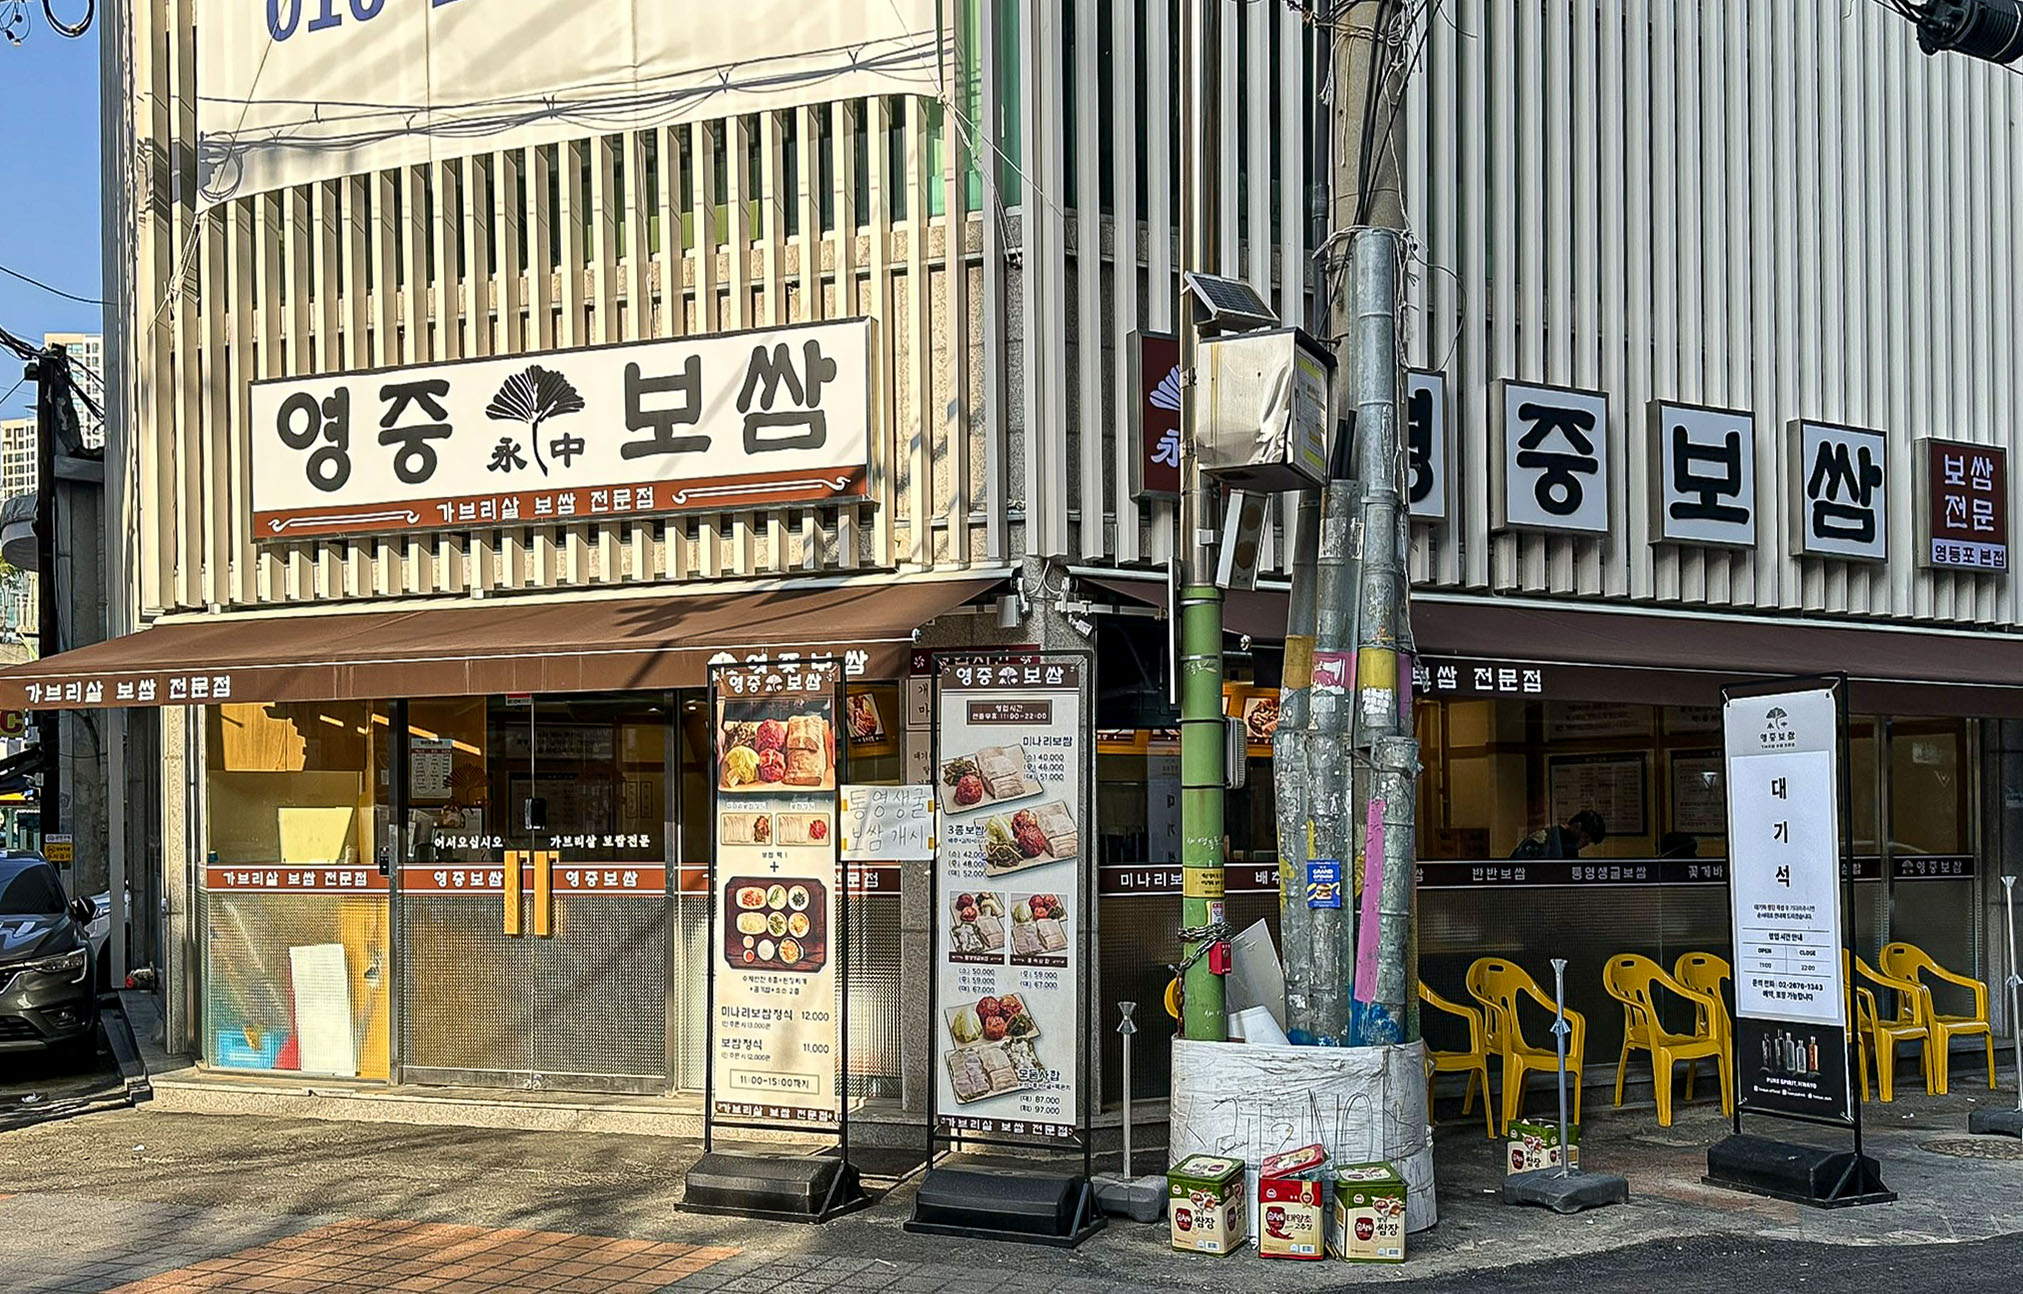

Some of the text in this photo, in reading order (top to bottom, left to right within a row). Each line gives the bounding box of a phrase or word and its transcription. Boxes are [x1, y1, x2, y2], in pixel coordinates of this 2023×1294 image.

[277, 339, 837, 492] 영중 보쌈
[1944, 453, 1994, 491] 보쌈
[435, 485, 656, 522] 가브리살 보쌈 전문점
[1944, 495, 1995, 531] 전문
[1935, 544, 2005, 567] 영등포 본점
[728, 674, 762, 694] 영중
[785, 672, 823, 692] 보쌈
[956, 665, 1065, 686] 영중 보쌈
[1474, 666, 1542, 693] 전문점
[25, 674, 232, 704] 가브리살 보쌈 전문점
[1023, 736, 1073, 748] 미나리보쌈
[849, 788, 929, 820] 통영생굴
[550, 834, 598, 849] 가브리살
[892, 824, 925, 850] 개시
[1771, 777, 1790, 888] 대기석
[434, 835, 504, 849] 어서오십시오
[1471, 865, 1526, 881] 반반보쌈
[1571, 865, 1647, 880] 통영생굴보쌈
[1916, 860, 1962, 874] 영중보쌈
[223, 870, 368, 887] 가브리살 보쌈 전문점
[433, 870, 503, 888] 영중보쌈
[565, 870, 639, 888] 영중보쌈
[721, 1006, 793, 1020] 미나리보쌈정식
[721, 1038, 763, 1050] 보쌈정식
[717, 1102, 763, 1117] 가브리살
[769, 1106, 791, 1119] 보쌈
[947, 1117, 1069, 1138] 가브리살 보쌈 전문점
[1193, 1215, 1216, 1230] 쌈장
[1375, 1224, 1400, 1236] 쌈장
